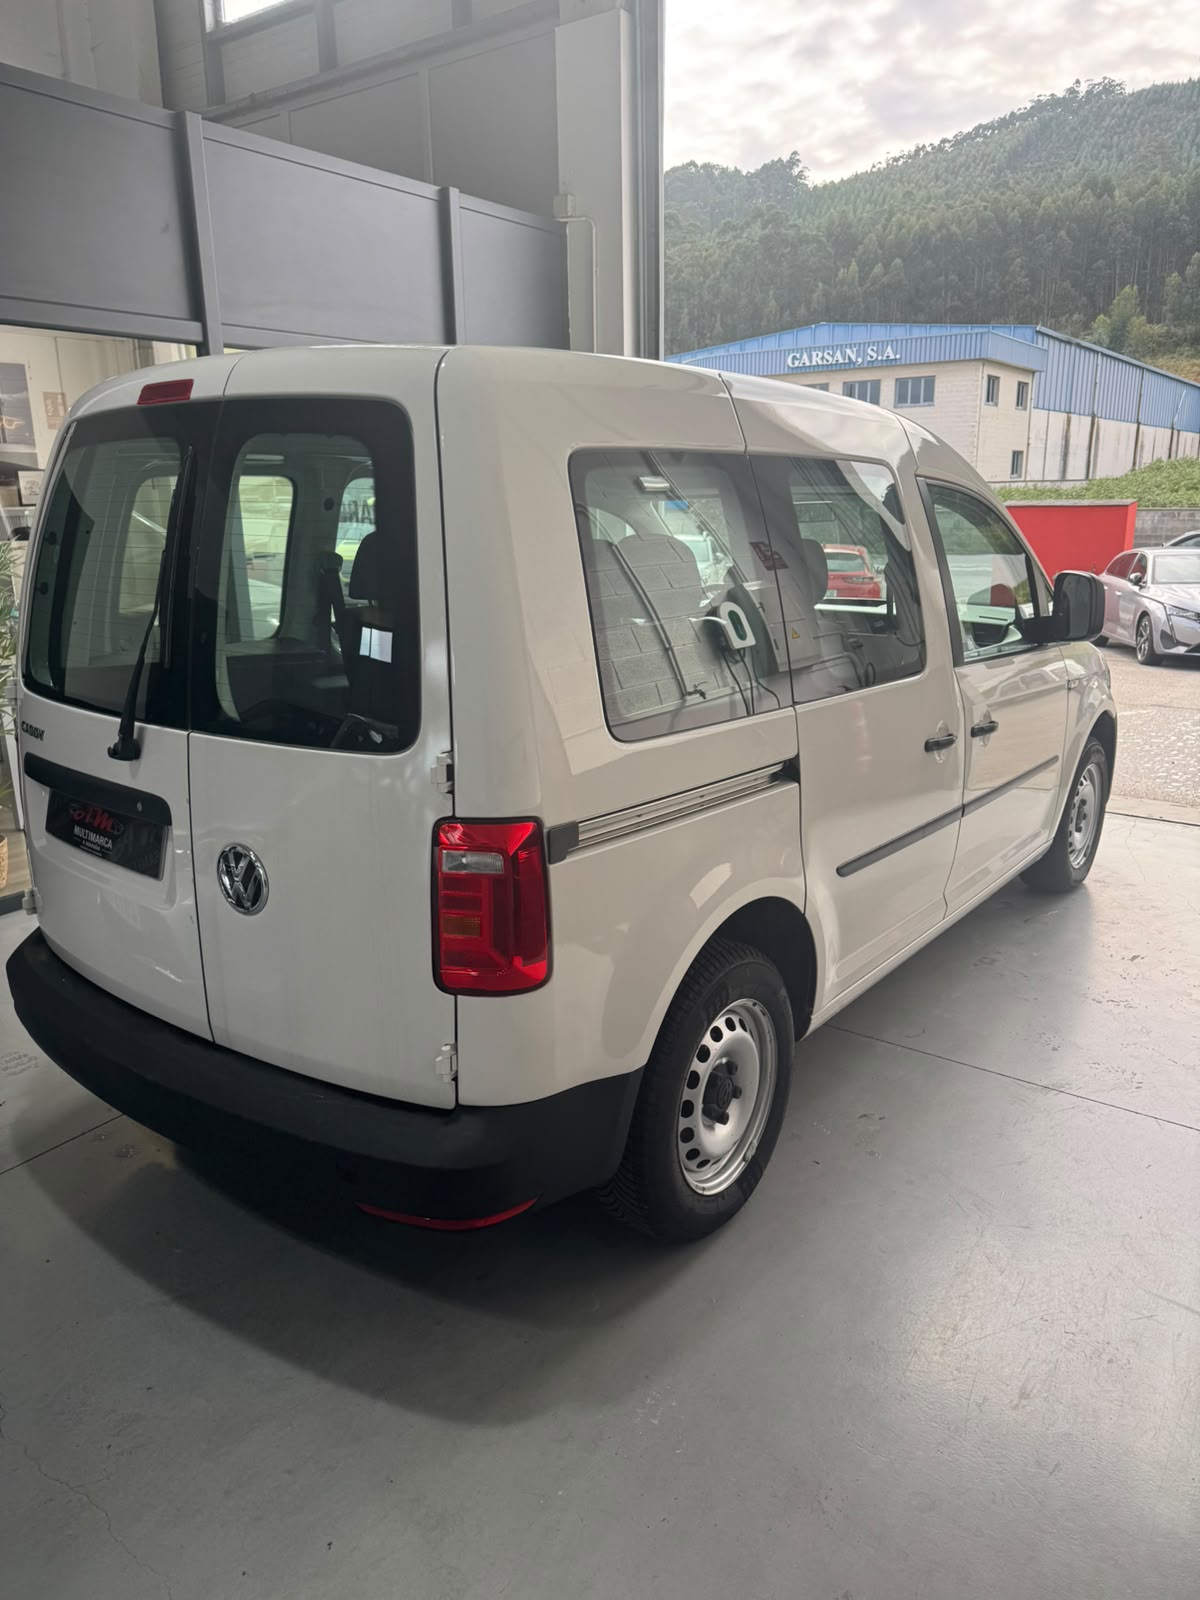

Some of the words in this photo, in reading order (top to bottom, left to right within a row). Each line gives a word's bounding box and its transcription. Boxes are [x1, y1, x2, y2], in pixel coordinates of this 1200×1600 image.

[787, 347, 863, 368] GARSAN,
[867, 344, 901, 361] S.A.
[73, 824, 113, 849] MULTIMARCA
